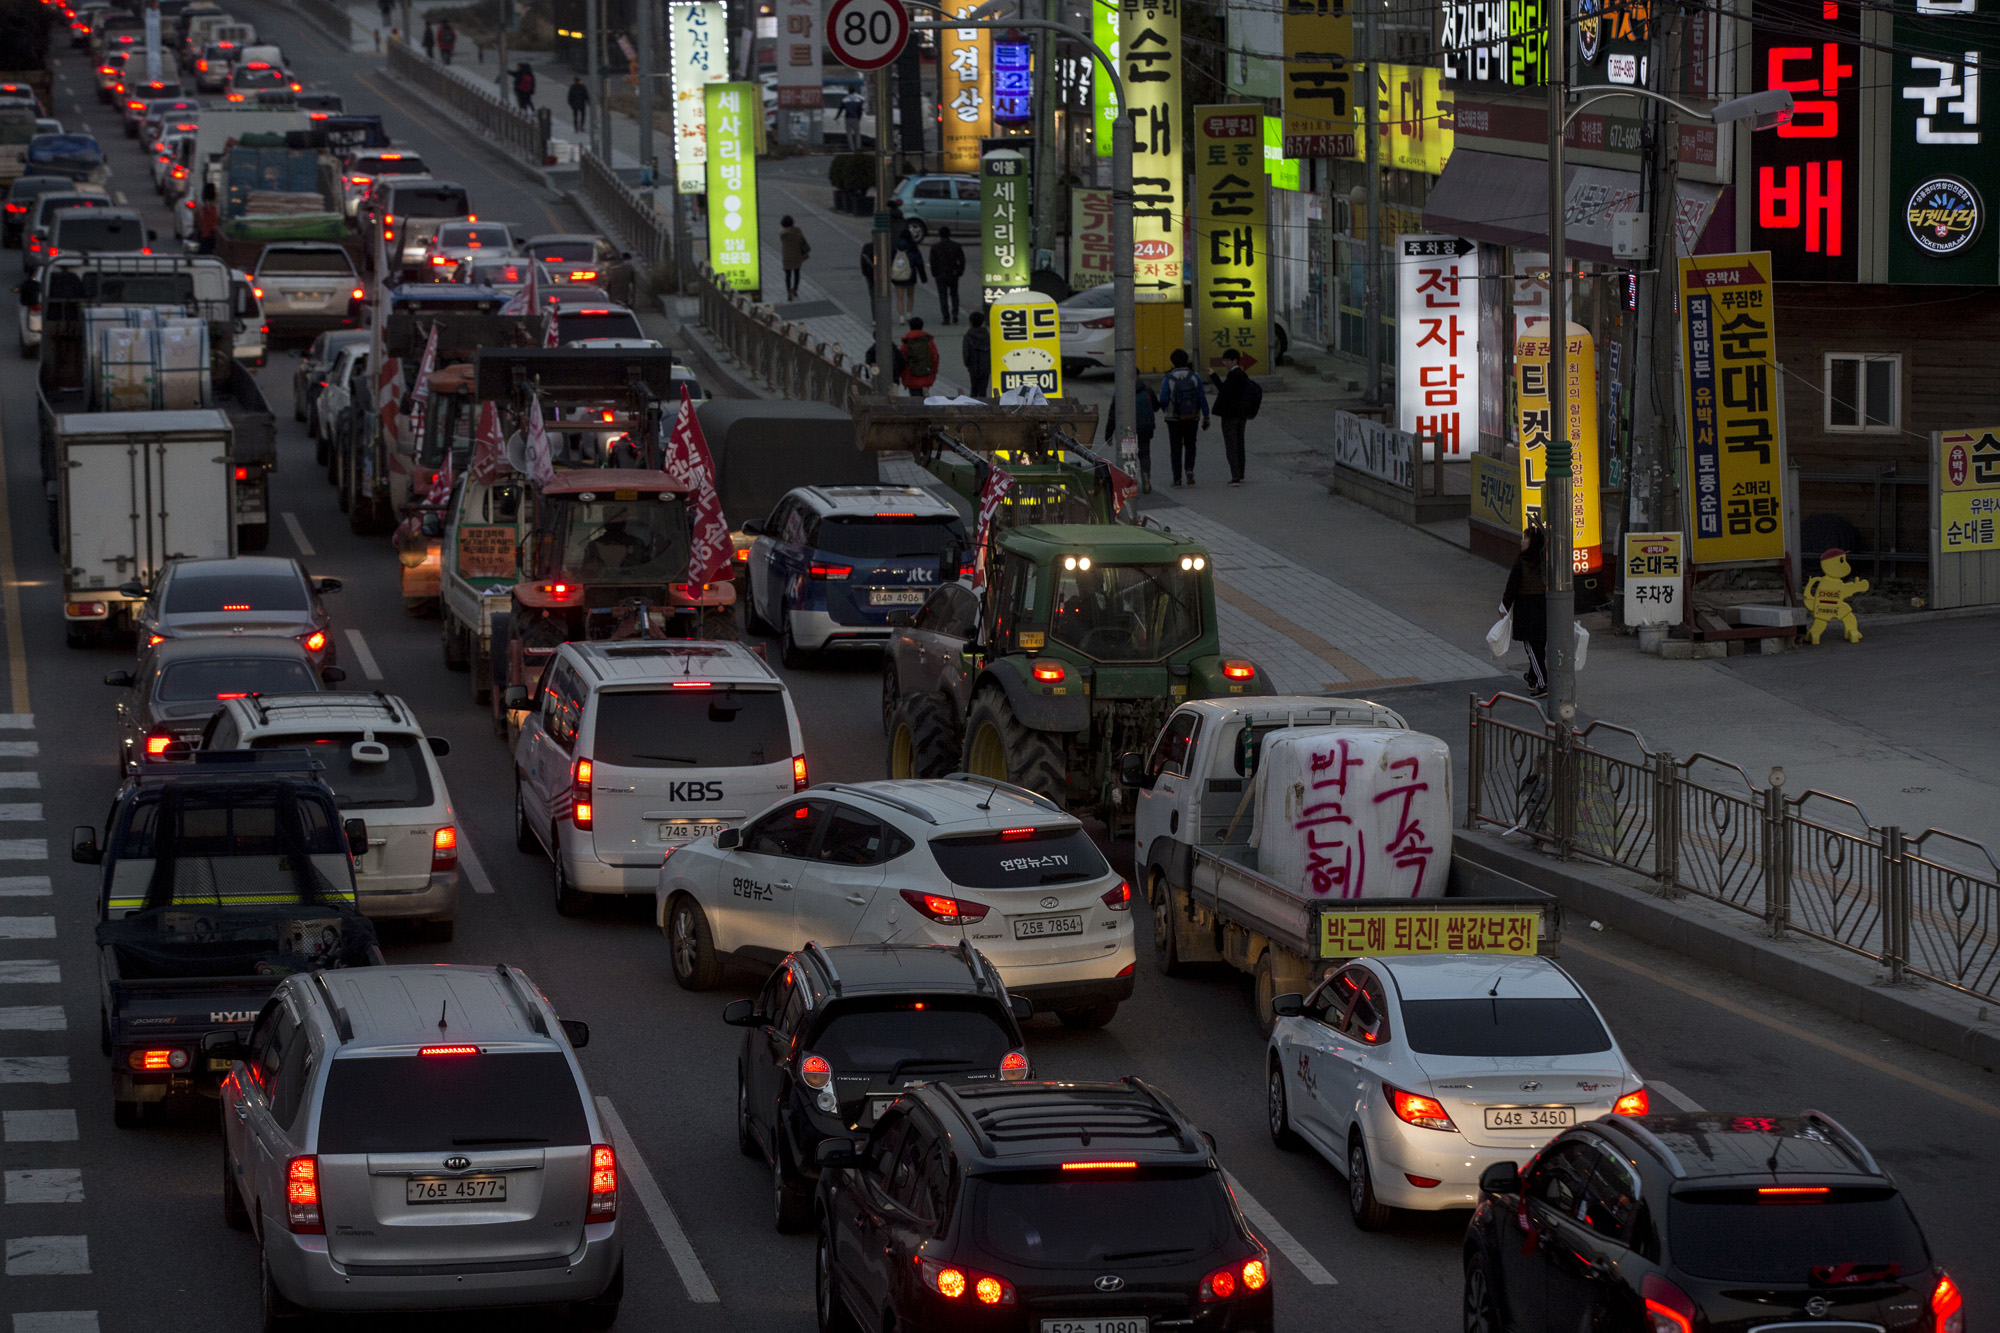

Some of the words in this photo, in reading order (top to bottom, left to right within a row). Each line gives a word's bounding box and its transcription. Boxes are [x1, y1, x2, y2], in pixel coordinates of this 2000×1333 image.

[786, 0, 813, 67] 마트
[844, 10, 891, 46] 80
[1442, 0, 1509, 84] 전자담배
[1692, 10, 1707, 87] 품권
[1902, 0, 1981, 145] 권
[718, 91, 742, 191] 세사리빙
[1126, 27, 1175, 233] 순대국
[1209, 116, 1255, 137] 무봉리
[1581, 121, 1603, 144] 안성총판
[1758, 0, 1853, 257] 담배
[992, 161, 1016, 175] 이불
[1565, 183, 1612, 228] 상품권
[1908, 208, 1978, 231] 티켓나라
[993, 181, 1017, 269] 세사리빙
[1133, 243, 1170, 258] 24시
[1207, 173, 1256, 321] 순대국
[1408, 241, 1457, 257] 주차장
[1919, 233, 1967, 250] TICKETNARA.net
[1705, 270, 1741, 285] 유박사
[1721, 289, 1764, 311] 푸짐한
[1000, 308, 1057, 342] 월드
[1211, 326, 1256, 349] 전문
[1690, 298, 1711, 380] 직접만든
[1415, 264, 1466, 456] 전자담배
[1517, 340, 1583, 363] 상품권라
[1567, 366, 1582, 400] 최고의
[1719, 312, 1775, 465] 순대국
[1694, 386, 1715, 447] 유박사
[1572, 452, 1586, 483] 다양한
[1951, 449, 1964, 483] 유박사
[1480, 473, 1516, 525] 티켓나라
[1698, 453, 1719, 534] 토종순대
[1732, 479, 1771, 498] 소머리
[1727, 497, 1780, 536] 곰탕
[1947, 518, 1996, 546] 순대를
[1628, 555, 1679, 575] 순대국
[897, 593, 920, 603] 4906
[1635, 585, 1675, 604] 주차장
[669, 781, 724, 802] KBS
[1374, 756, 1434, 898] 구속
[999, 854, 1069, 873] 연합뉴스TV
[732, 876, 774, 902] 연합뉴스
[1021, 922, 1044, 936] 25로
[1048, 918, 1078, 933] 7854
[1327, 917, 1386, 952] 박근혜
[1394, 917, 1439, 952] 퇴진!
[1446, 917, 1533, 953] 쌀값보장!
[1493, 1111, 1522, 1126] 64호
[1529, 1110, 1567, 1125] 3450
[447, 1158, 470, 1168] KIA
[455, 1181, 498, 1198] 4577
[1097, 1318, 1141, 1333] 1080
